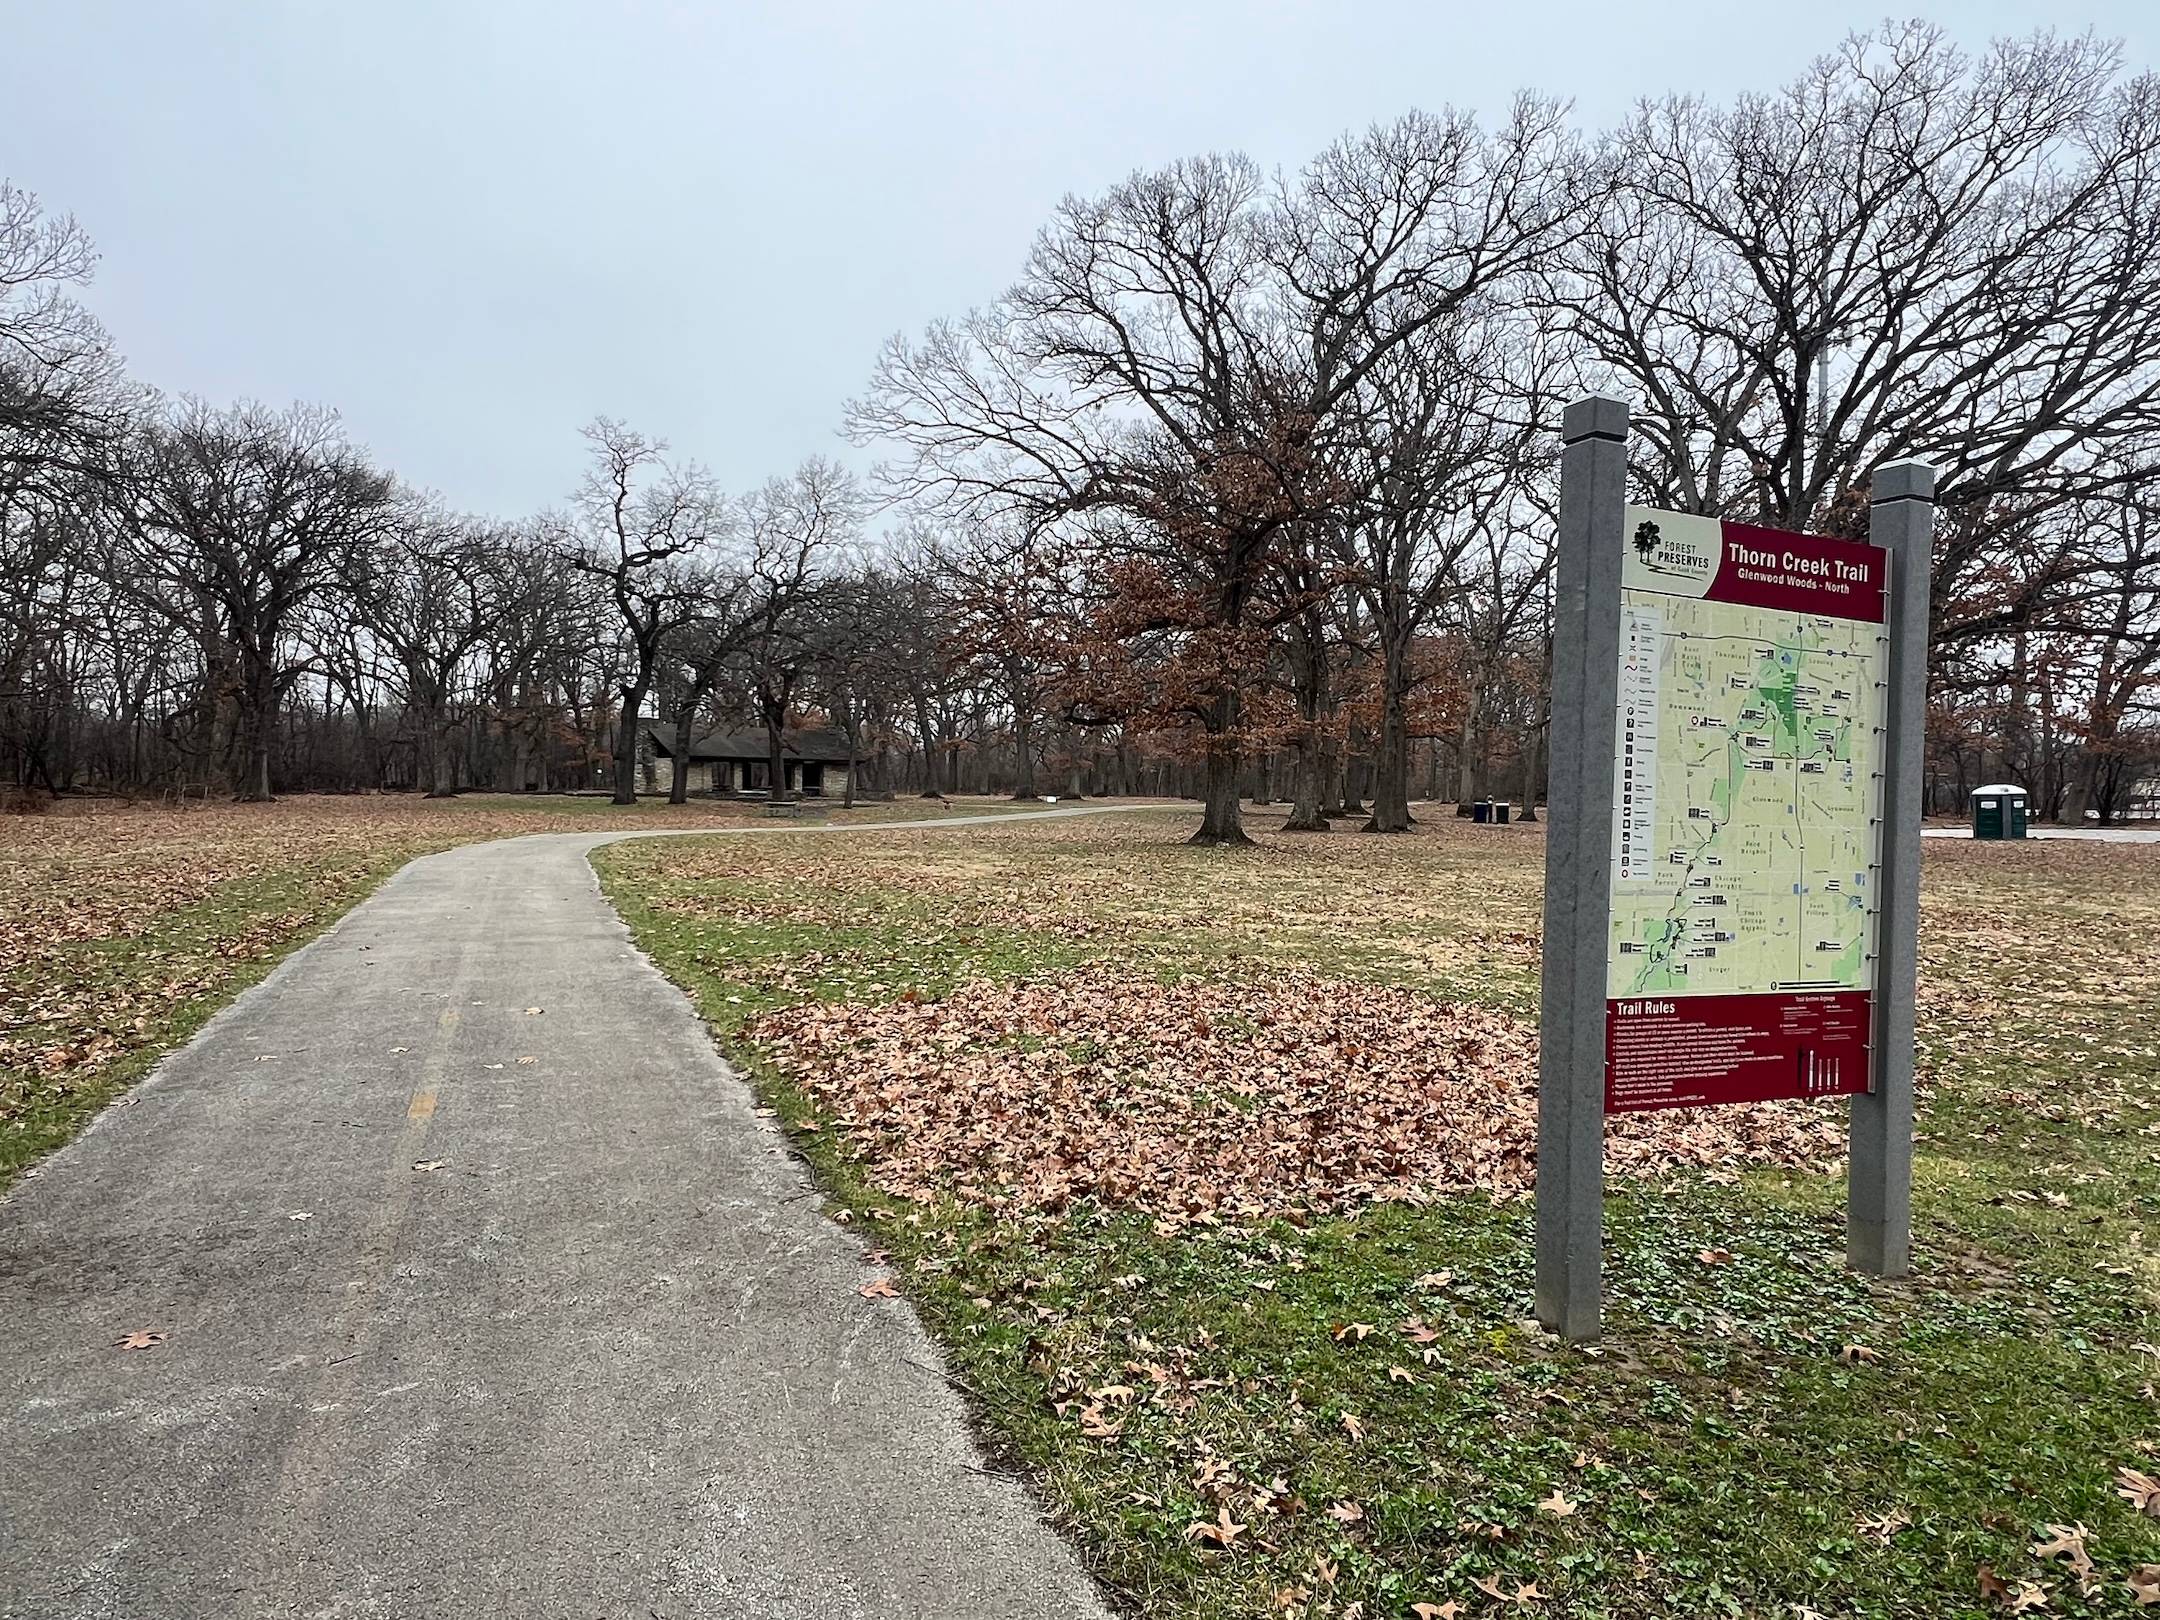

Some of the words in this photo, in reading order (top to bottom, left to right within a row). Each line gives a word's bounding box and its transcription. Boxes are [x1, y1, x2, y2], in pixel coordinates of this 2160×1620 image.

[1665, 541, 1696, 554] FOREST
[1658, 551, 1709, 569] PRESERVES
[1729, 542, 1776, 569] Thorn
[1783, 551, 1829, 577] Creek
[1835, 560, 1869, 583] Trail
[1738, 567, 1785, 585] Glenwood
[1787, 575, 1817, 590] Woods
[1825, 581, 1850, 594] North
[1617, 1001, 1642, 1016] Trail
[1645, 1001, 1676, 1015] Rules
